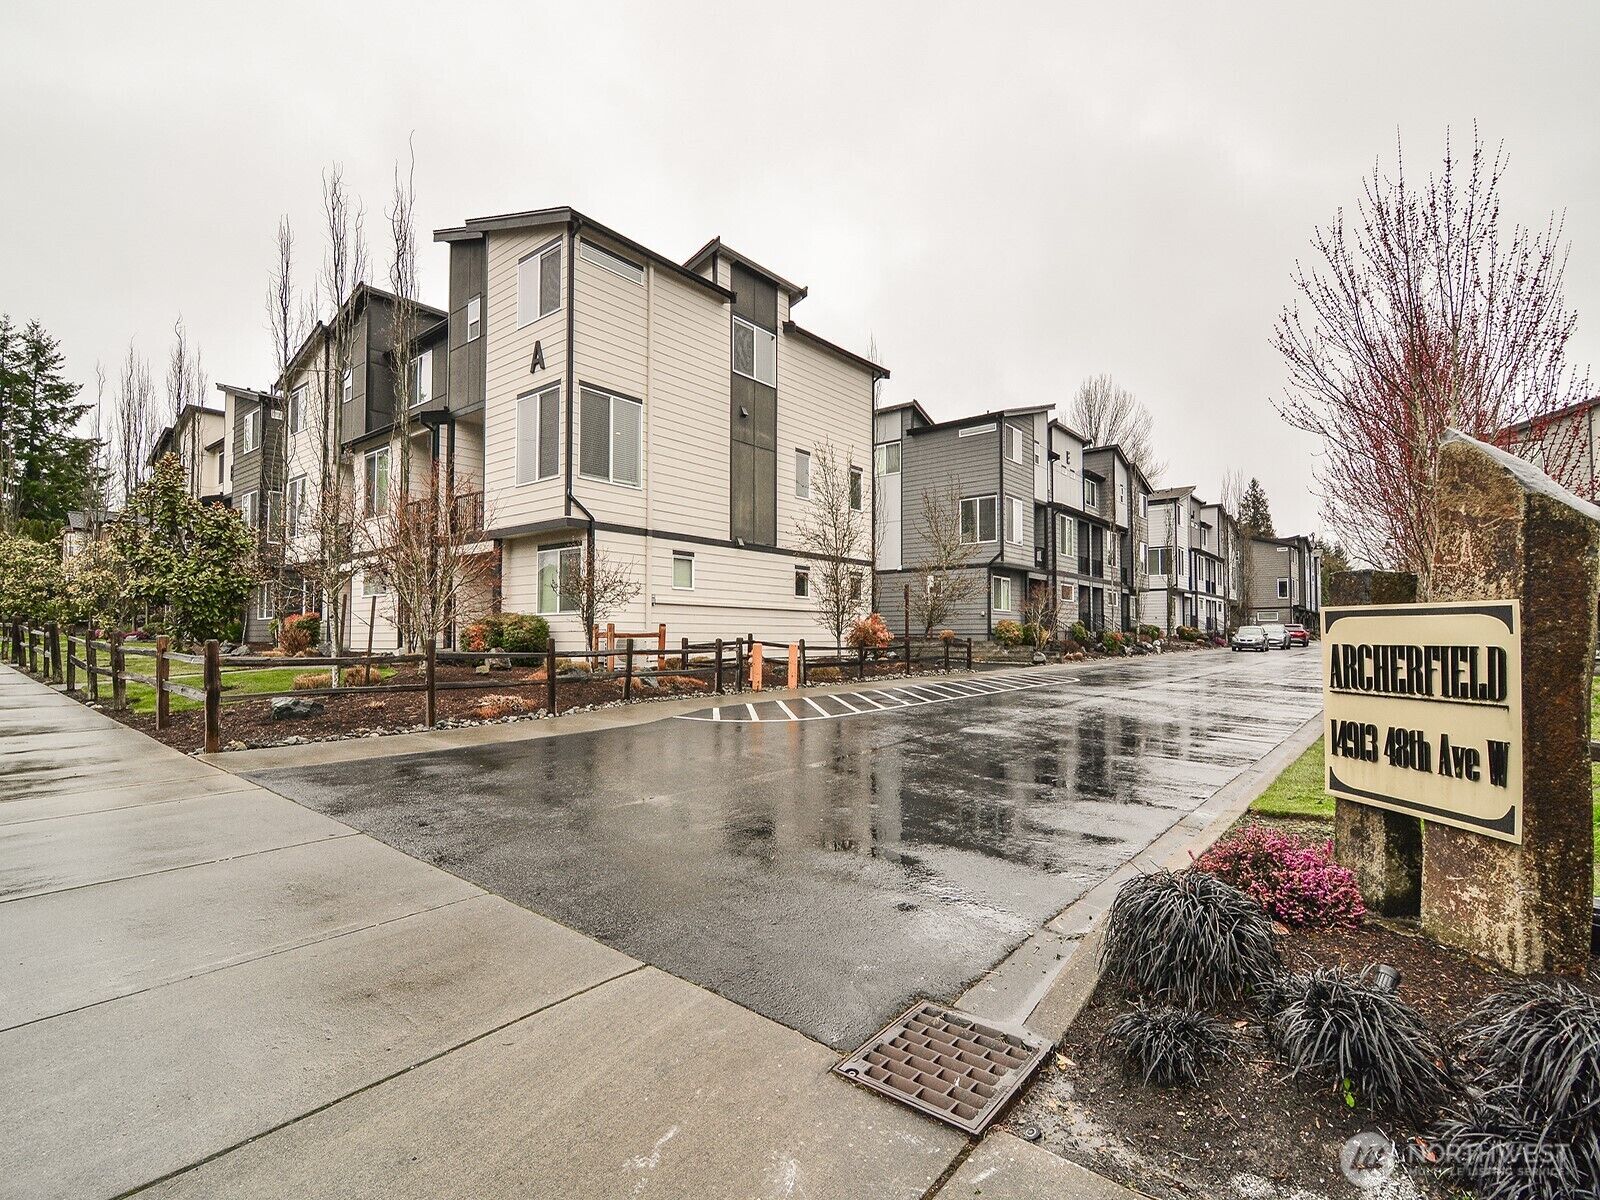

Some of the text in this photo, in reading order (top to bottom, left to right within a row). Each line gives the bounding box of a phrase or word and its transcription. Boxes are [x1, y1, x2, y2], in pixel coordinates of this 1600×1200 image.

[530, 340, 546, 374] A
[1330, 643, 1508, 701] ARCHERFIELD
[1331, 719, 1511, 788] 14913 48th Ave W
